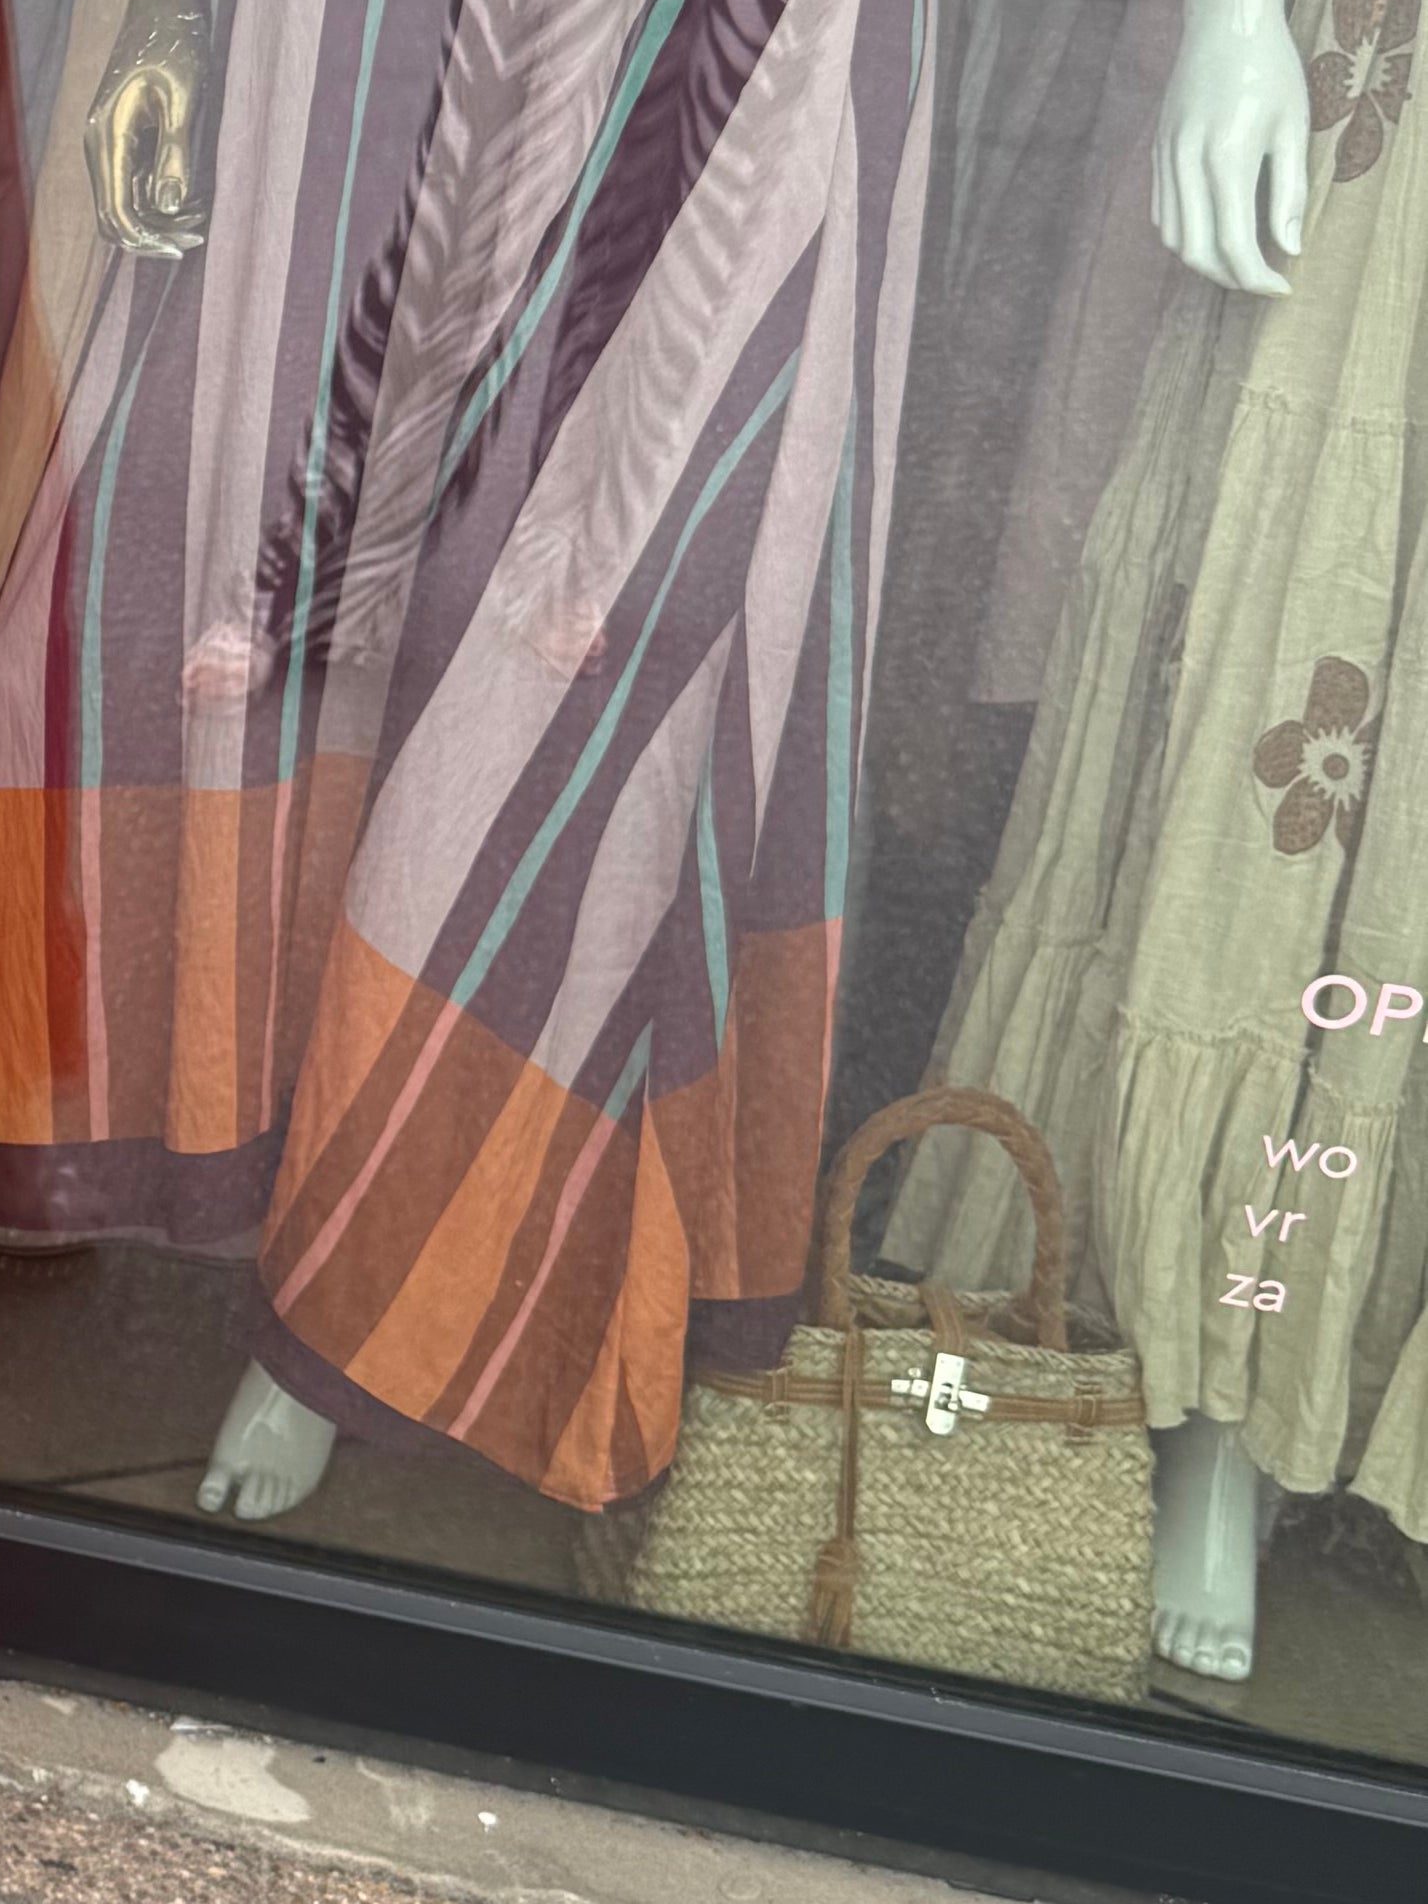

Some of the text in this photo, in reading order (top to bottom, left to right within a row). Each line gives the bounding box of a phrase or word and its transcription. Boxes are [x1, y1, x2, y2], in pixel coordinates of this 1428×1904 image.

[1301, 974, 1428, 1045] OP
[1262, 1135, 1358, 1179] wo
[1245, 1204, 1307, 1243] vr
[1218, 1273, 1286, 1313] za
